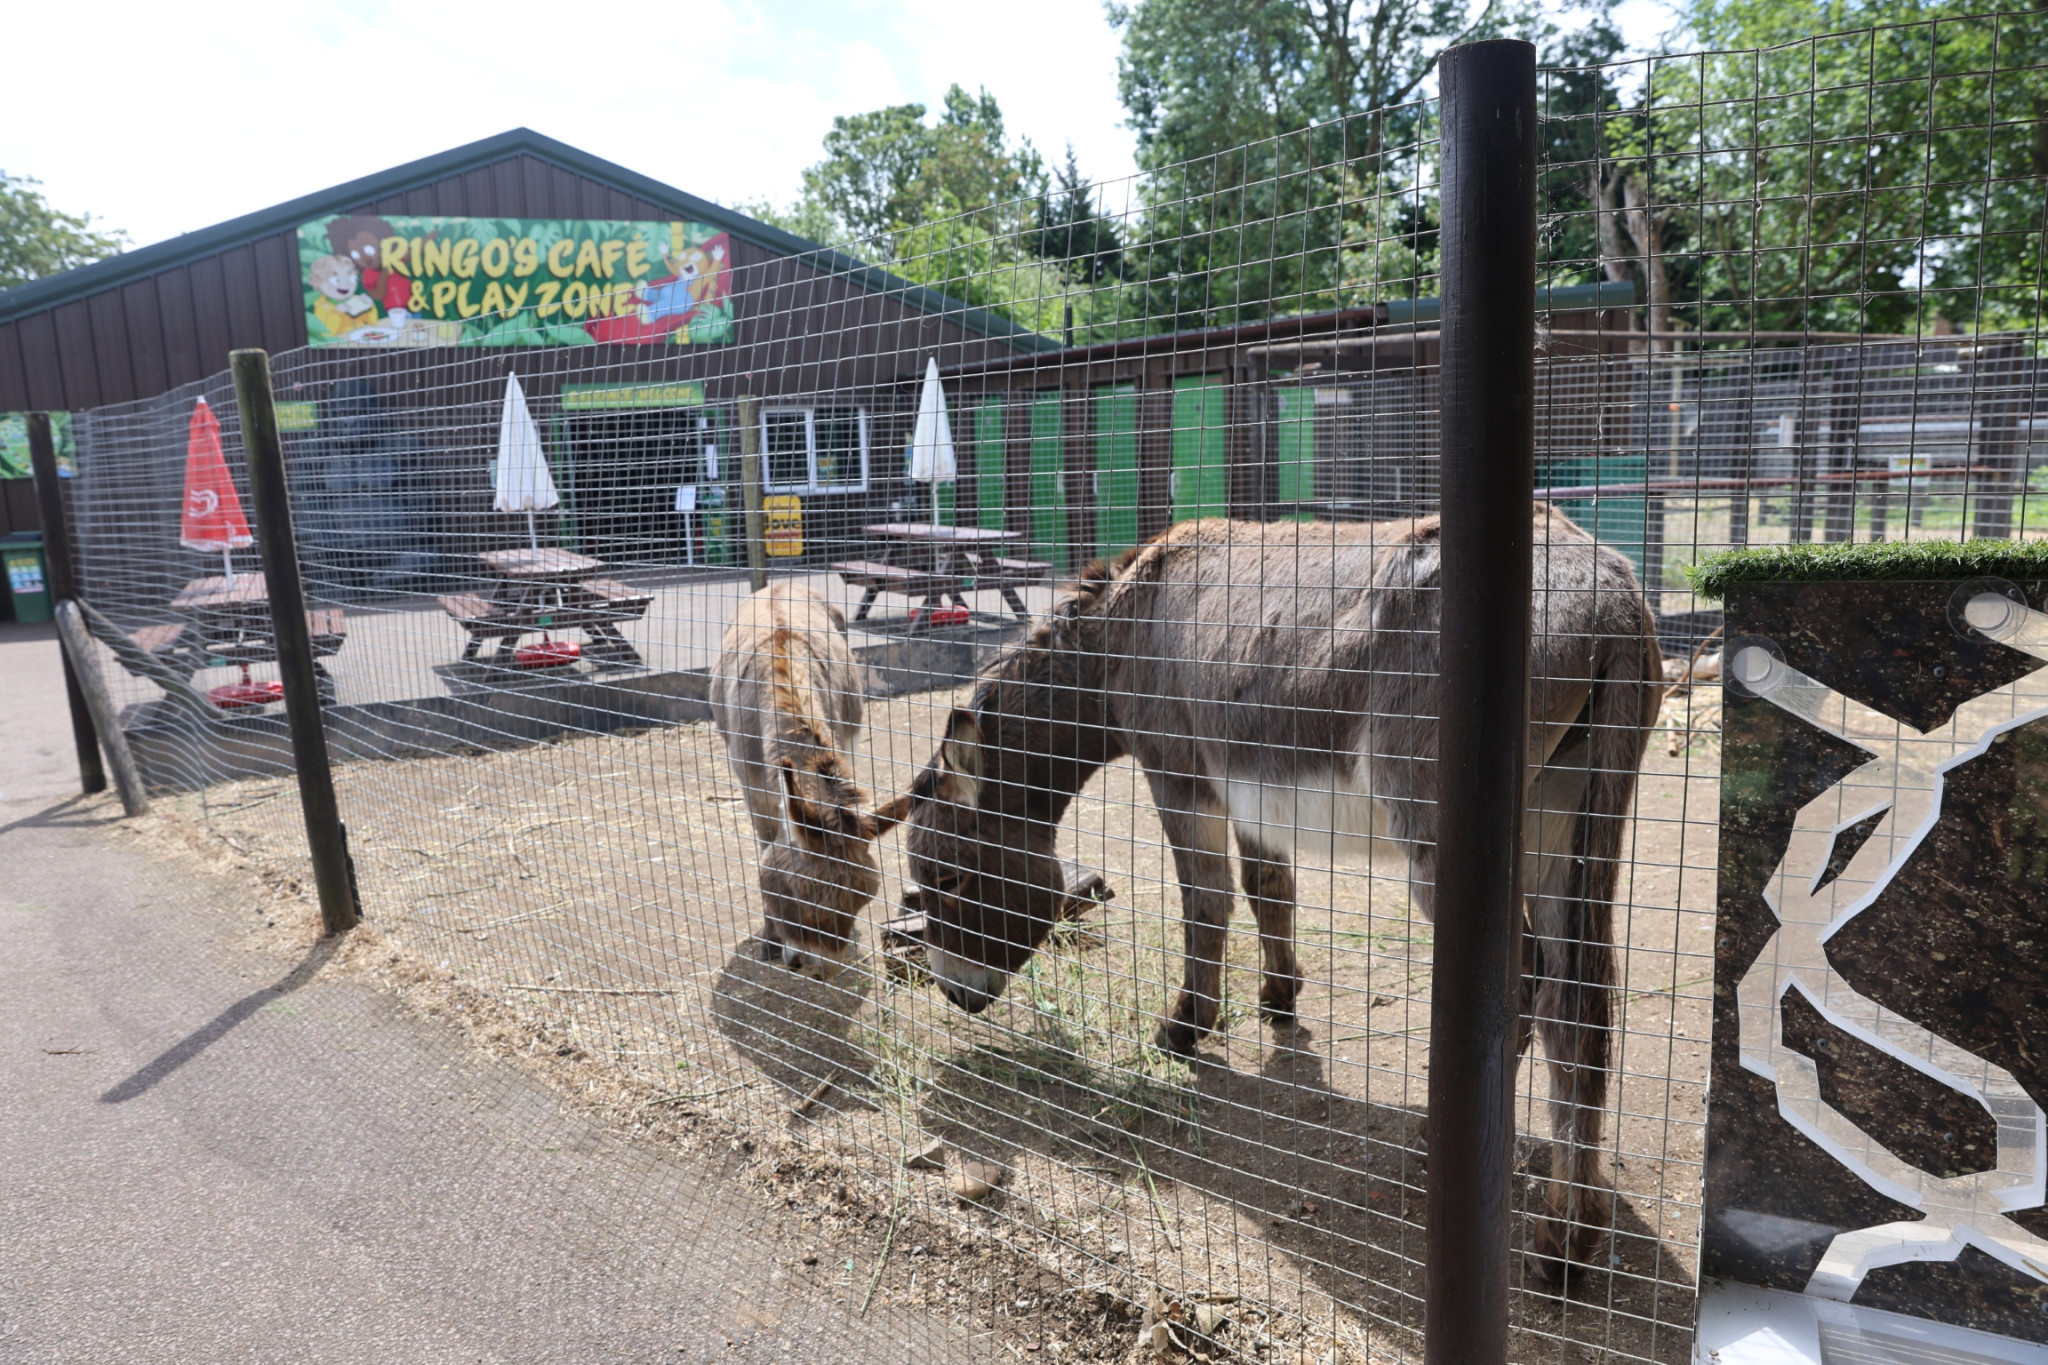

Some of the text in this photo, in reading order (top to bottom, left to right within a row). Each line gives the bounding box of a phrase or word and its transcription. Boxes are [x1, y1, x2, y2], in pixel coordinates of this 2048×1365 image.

[380, 233, 651, 278] RINGO'S CAFÉ
[407, 280, 636, 319] & PLAY ZONE
